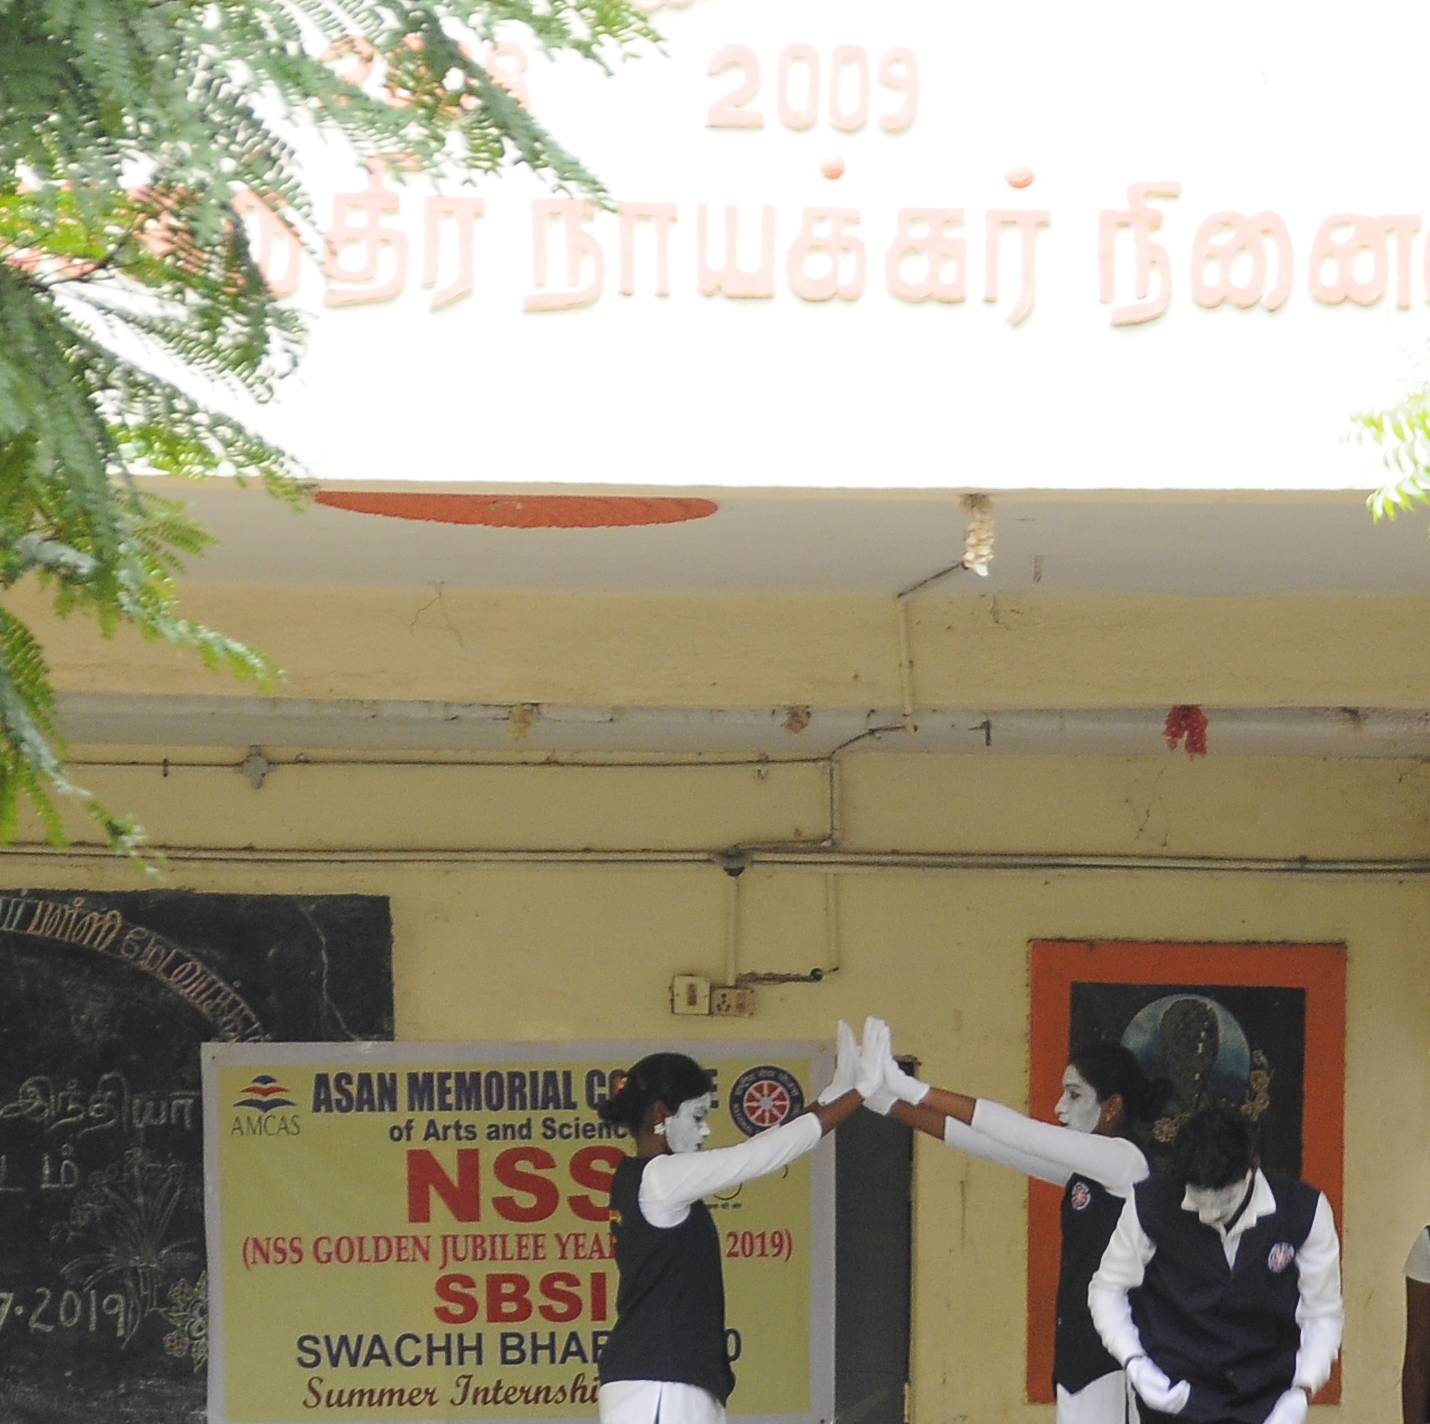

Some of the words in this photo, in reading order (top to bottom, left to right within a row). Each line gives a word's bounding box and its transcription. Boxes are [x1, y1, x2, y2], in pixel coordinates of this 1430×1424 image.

[708, 44, 921, 132] 2009
[526, 158, 1052, 327] நாயக்கர்
[312, 1071, 398, 1113] ASAN
[407, 1069, 578, 1112] MEMORIAL
[231, 1115, 301, 1136] AMCAS
[389, 1118, 414, 1142] of
[423, 1118, 478, 1142] Arts
[486, 1117, 532, 1140] and
[541, 1116, 629, 1140] Scienc
[406, 1145, 625, 1223] NSS
[242, 1236, 303, 1269] (NSS
[312, 1235, 430, 1265] GOLDEN
[438, 1233, 547, 1270] JUBILEE
[433, 1271, 607, 1325] SBSI
[296, 1331, 483, 1368] SWACHH
[302, 1375, 439, 1409] Summer
[449, 1371, 600, 1406] Internshi
